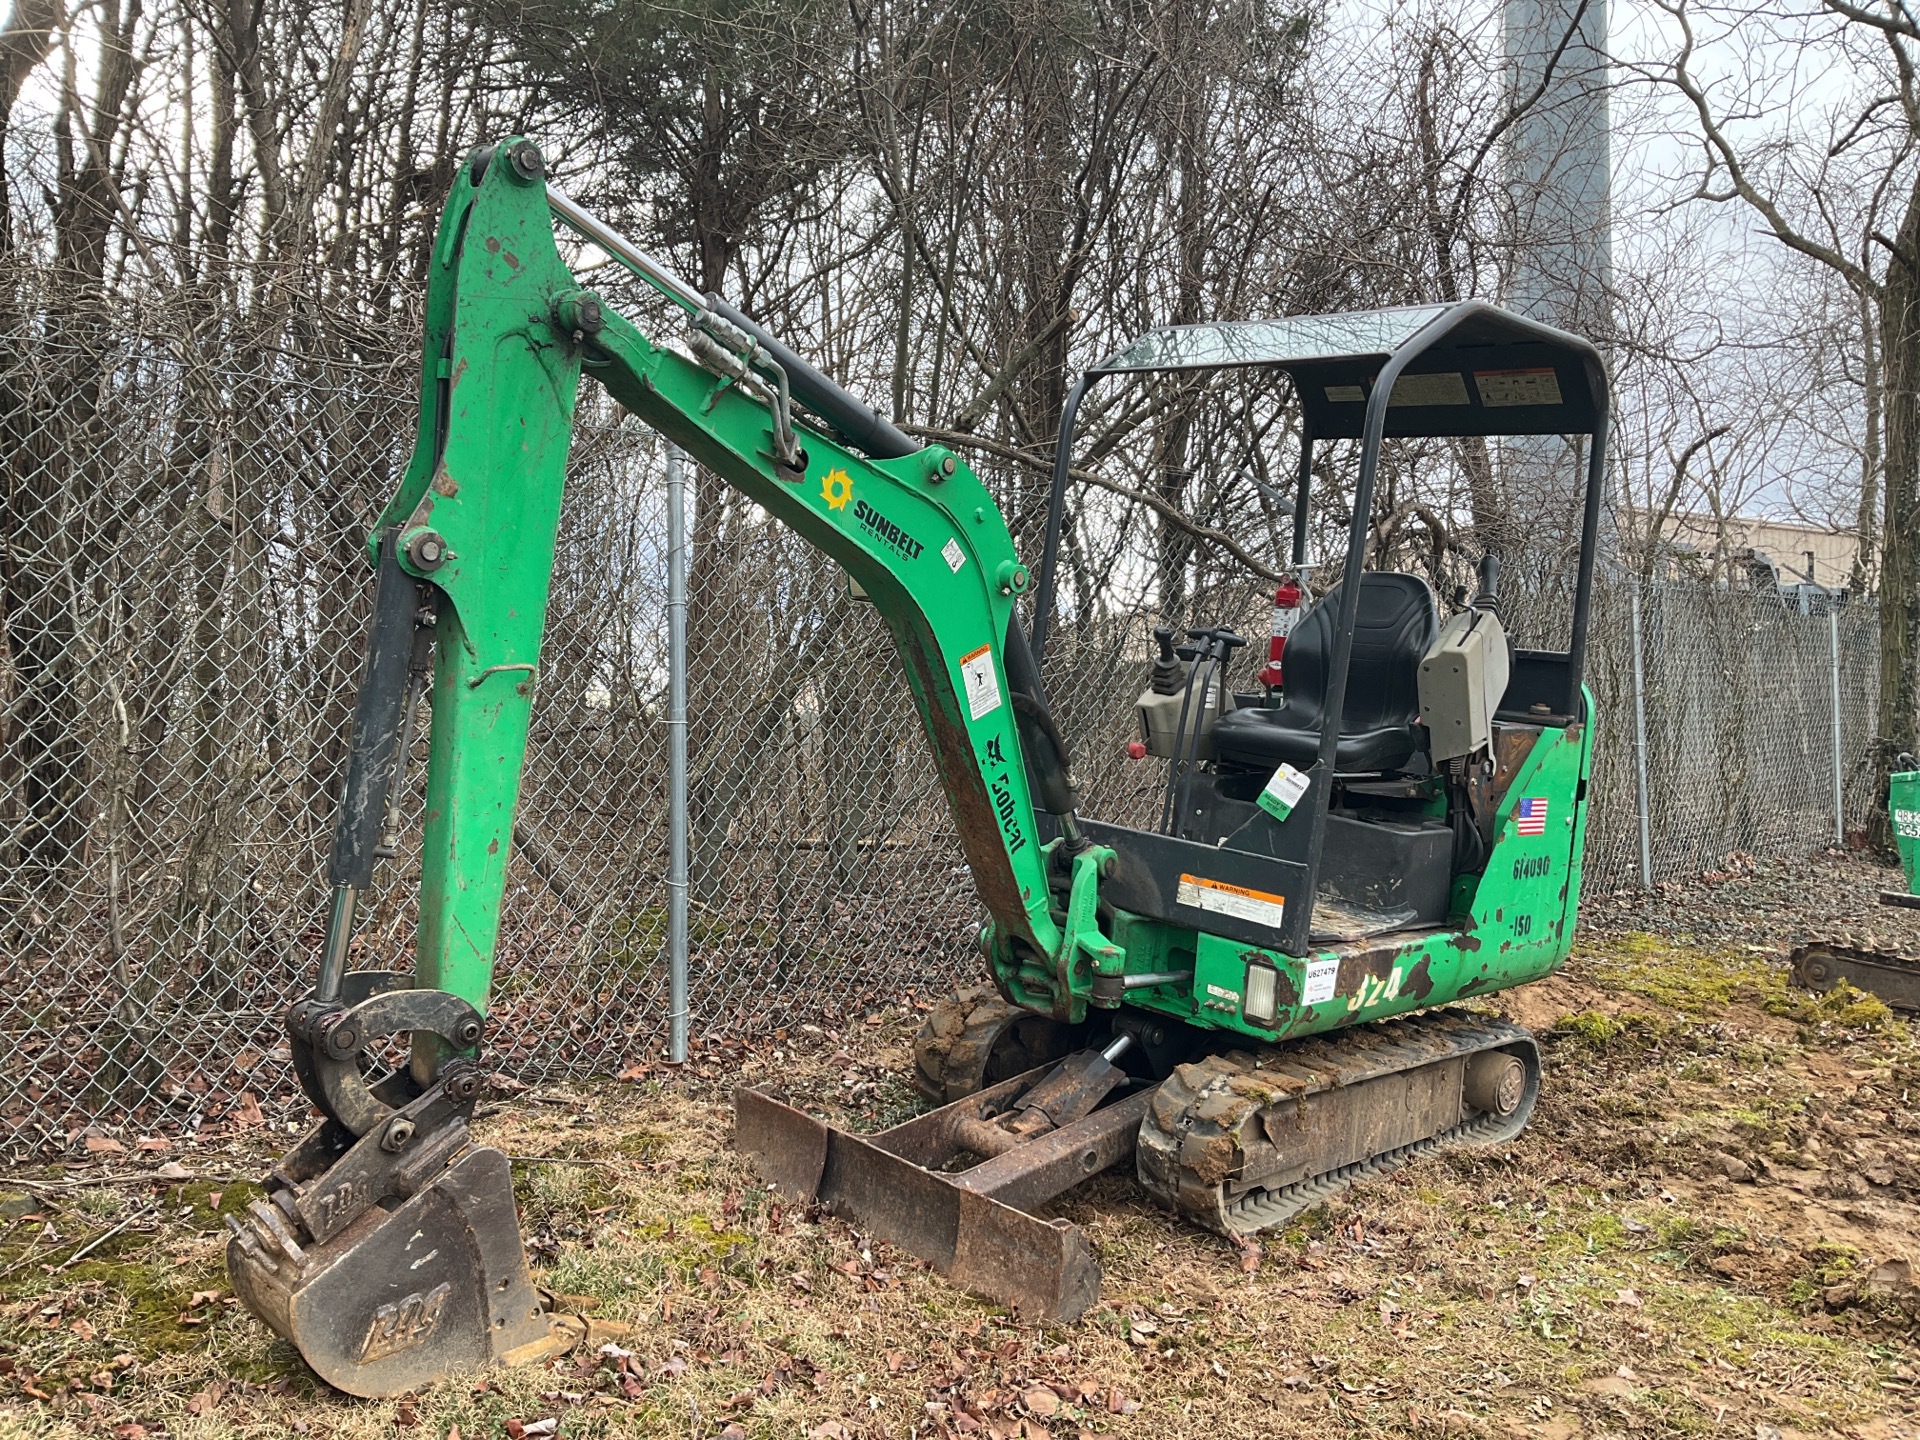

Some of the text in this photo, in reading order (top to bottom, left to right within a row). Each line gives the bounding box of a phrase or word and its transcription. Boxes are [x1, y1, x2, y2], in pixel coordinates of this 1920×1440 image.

[853, 499, 925, 560] SUNBELT
[860, 522, 910, 562] RENTALS
[1219, 884, 1250, 896] WARNING
[1308, 967, 1336, 979] U627479
